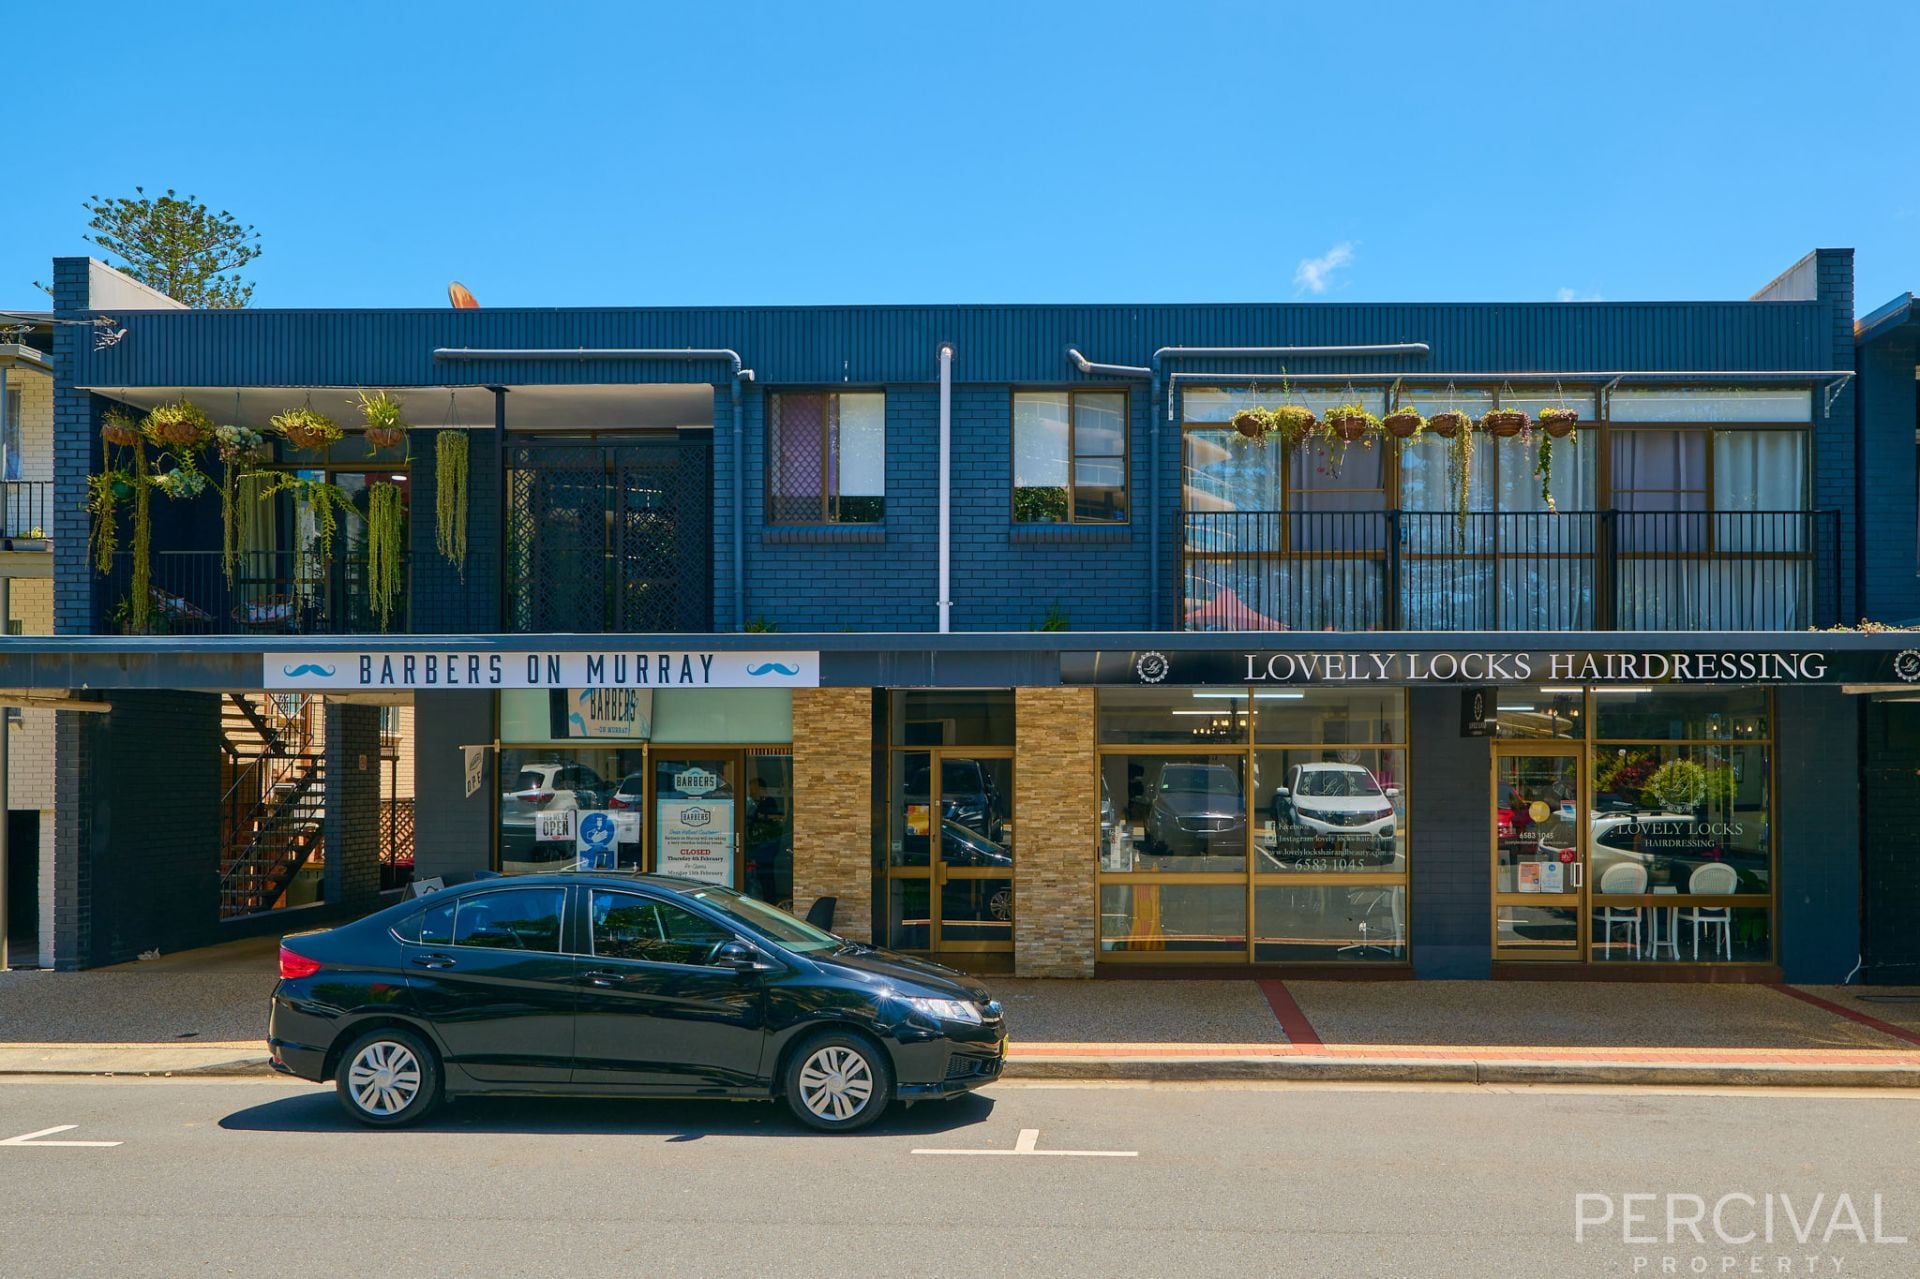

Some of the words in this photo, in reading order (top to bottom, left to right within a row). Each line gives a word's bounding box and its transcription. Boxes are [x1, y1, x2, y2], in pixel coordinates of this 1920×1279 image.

[359, 654, 502, 684] BARBERS
[527, 654, 561, 684] ON
[586, 654, 714, 684] MURRAY
[1244, 654, 1396, 680] LOVELY
[1406, 653, 1533, 680] LOCKS
[1548, 653, 1828, 680] HAIRDRESSING
[590, 687, 636, 721] BARBERS
[676, 775, 715, 787] BARBERS
[543, 820, 568, 836] OPEN
[1618, 823, 1683, 835] LOVELY
[1688, 823, 1743, 835] LOCKS
[1295, 859, 1328, 871] 6583
[1333, 859, 1365, 871] 1045
